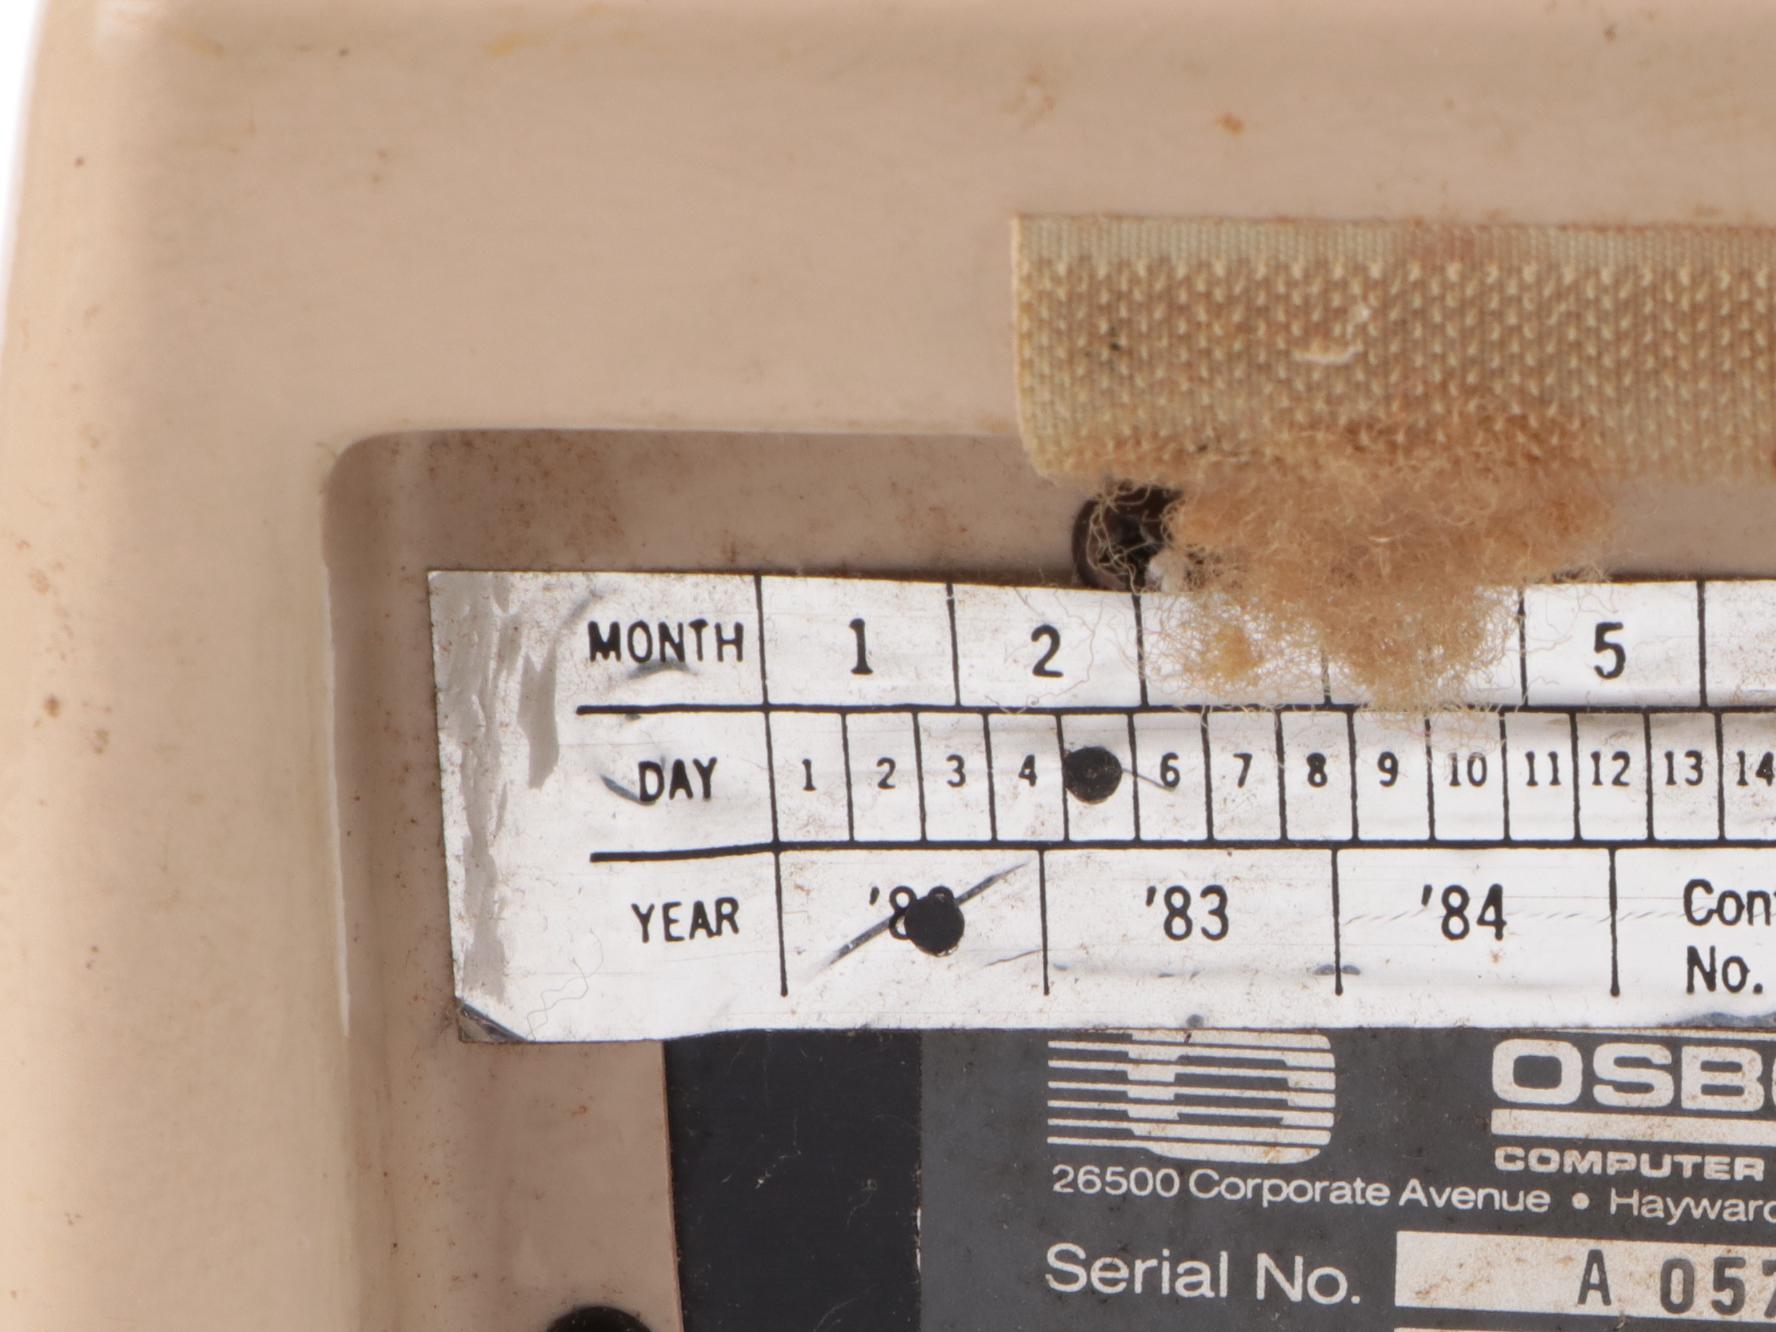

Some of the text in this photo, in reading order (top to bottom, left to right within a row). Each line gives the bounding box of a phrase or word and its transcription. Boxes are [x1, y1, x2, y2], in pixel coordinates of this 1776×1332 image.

[588, 619, 744, 667] MONTH
[849, 617, 874, 676] 1
[1030, 623, 1064, 680] 2
[1592, 620, 1628, 681] 5
[636, 755, 719, 803] DAY
[801, 757, 818, 792] 1
[876, 757, 897, 792] 2
[946, 754, 967, 789] 3
[1017, 755, 1039, 788] 4
[1160, 752, 1180, 787] 6
[1233, 754, 1254, 788] 7
[1306, 753, 1328, 788] 8
[1378, 753, 1401, 788] 9
[1447, 753, 1488, 788] 10
[1525, 753, 1563, 787] 11
[1590, 753, 1632, 788] 12
[1663, 751, 1705, 787] 13
[1735, 751, 1776, 787] 14
[631, 896, 741, 945] YEAR
[868, 885, 958, 943] '8
[1144, 884, 1231, 944] '83
[1420, 883, 1508, 944] '84
[1686, 945, 1766, 997] No.
[1051, 1163, 1181, 1199] 26500
[1188, 1167, 1392, 1208] Corporate
[1399, 1178, 1552, 1214] Avenue
[1494, 1146, 1765, 1183] COMPUTER
[1044, 1242, 1230, 1299] Serial
[1255, 1252, 1362, 1306] No.
[1576, 1248, 1612, 1307] A
